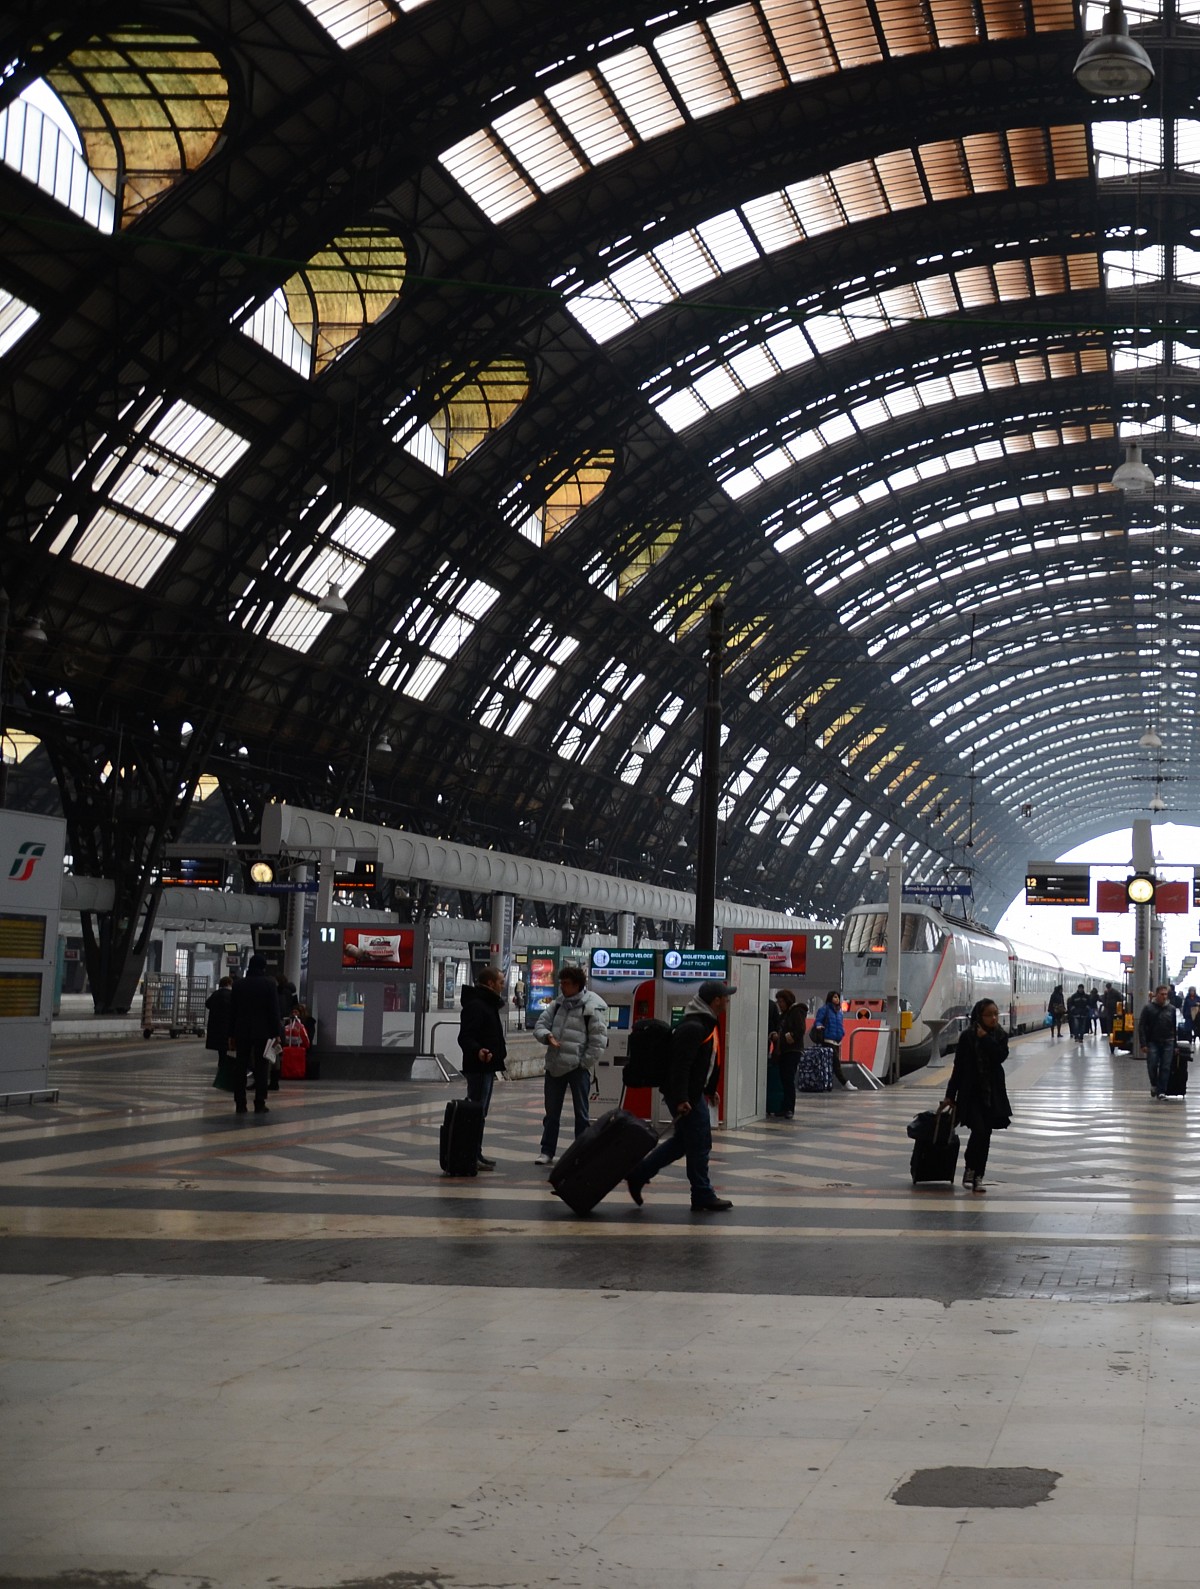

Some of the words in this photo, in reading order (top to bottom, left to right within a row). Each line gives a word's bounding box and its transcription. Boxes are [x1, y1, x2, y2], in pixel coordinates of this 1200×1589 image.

[365, 864, 374, 873] 11
[1027, 878, 1037, 887] 12
[905, 885, 930, 893] Smoking
[320, 927, 336, 942] 11
[813, 935, 833, 950] 12
